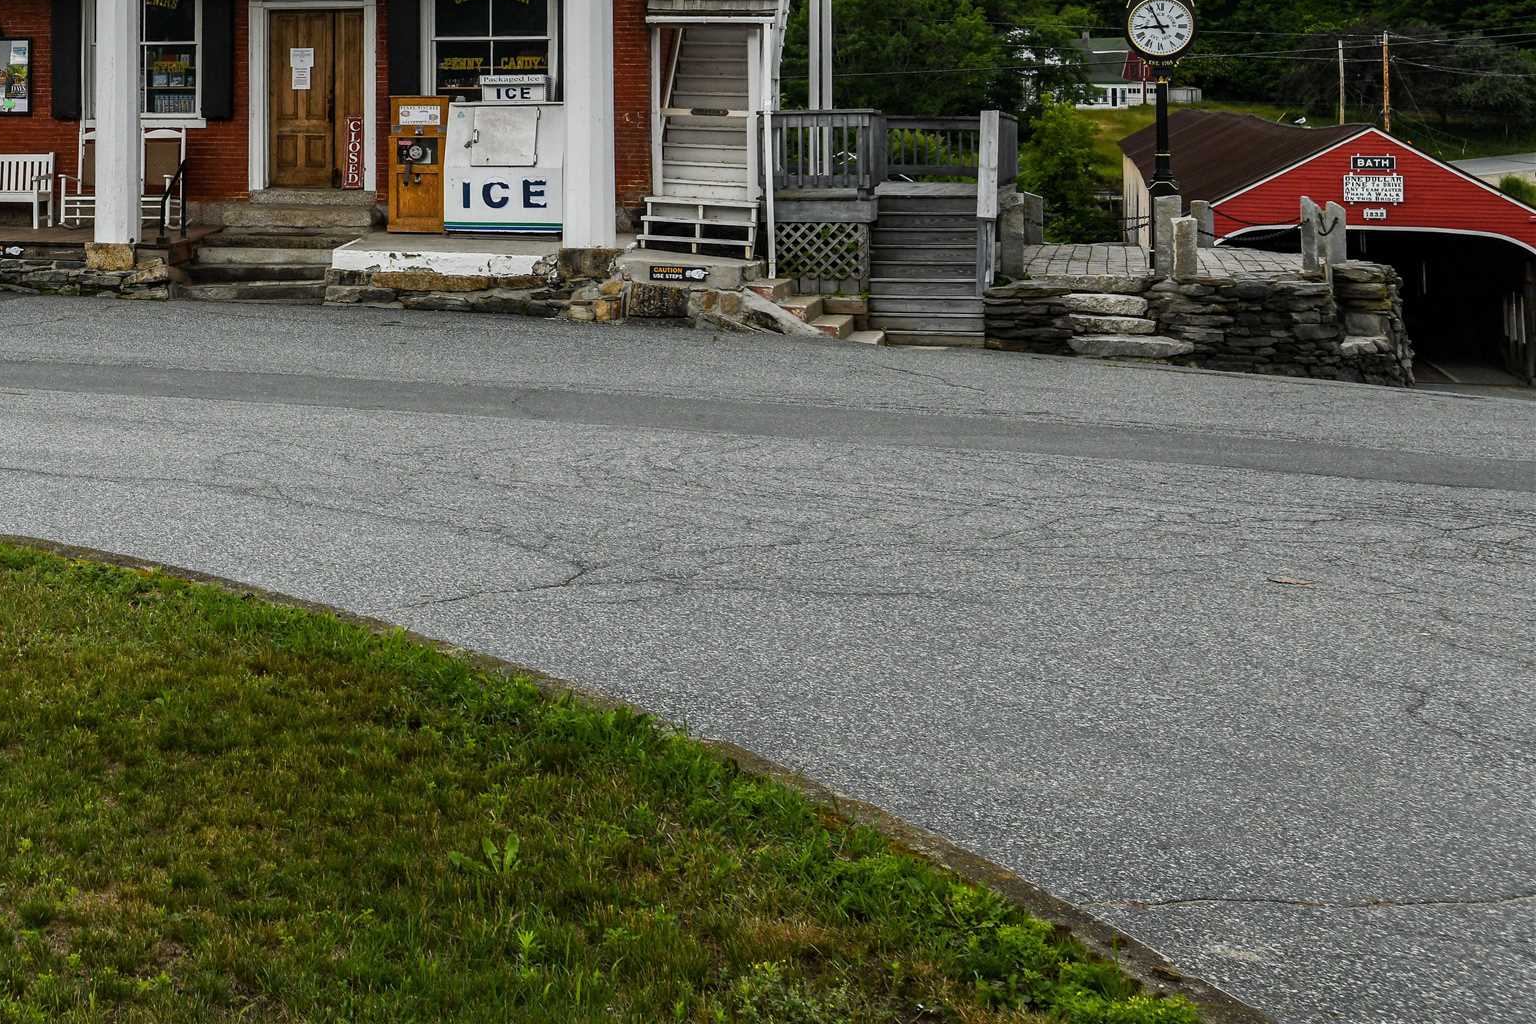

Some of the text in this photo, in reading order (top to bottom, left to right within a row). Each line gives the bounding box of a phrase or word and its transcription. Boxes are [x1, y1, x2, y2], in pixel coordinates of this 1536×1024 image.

[442, 56, 541, 70] PENNY CANDY
[496, 87, 532, 99] ICE
[348, 121, 360, 183] CLOSED
[1357, 159, 1389, 167] BATH
[462, 178, 547, 208] ICE
